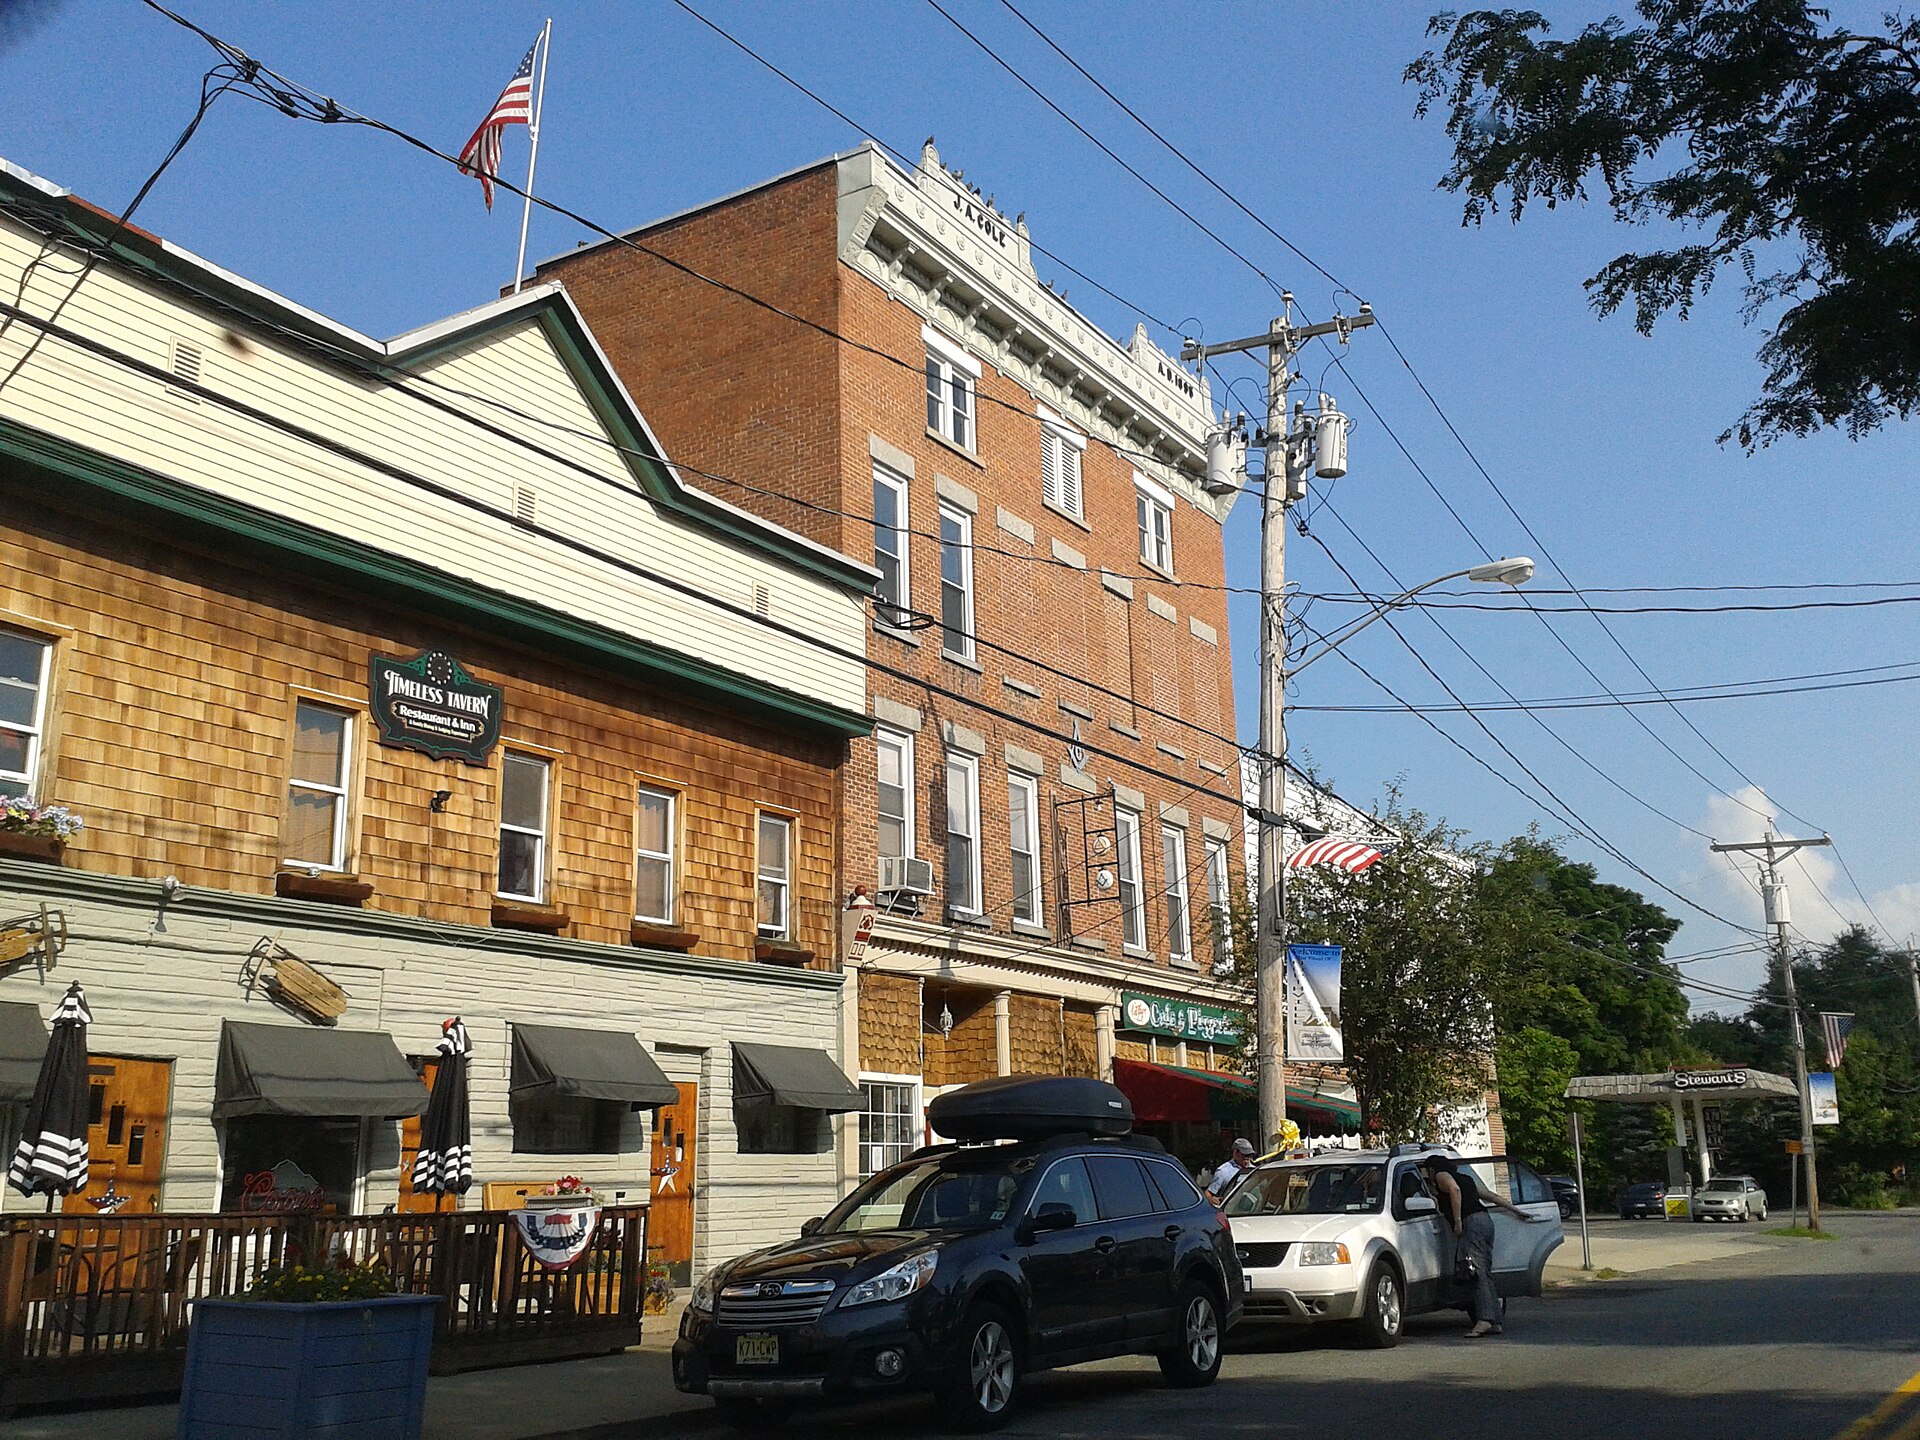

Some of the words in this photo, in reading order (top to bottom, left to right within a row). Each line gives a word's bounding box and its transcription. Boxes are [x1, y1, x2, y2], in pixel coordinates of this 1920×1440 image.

[384, 669, 443, 704] TIMELESS
[447, 691, 492, 719] TAVERN
[399, 704, 451, 726] Restaurant
[451, 717, 460, 728] &
[460, 719, 476, 732] Inn
